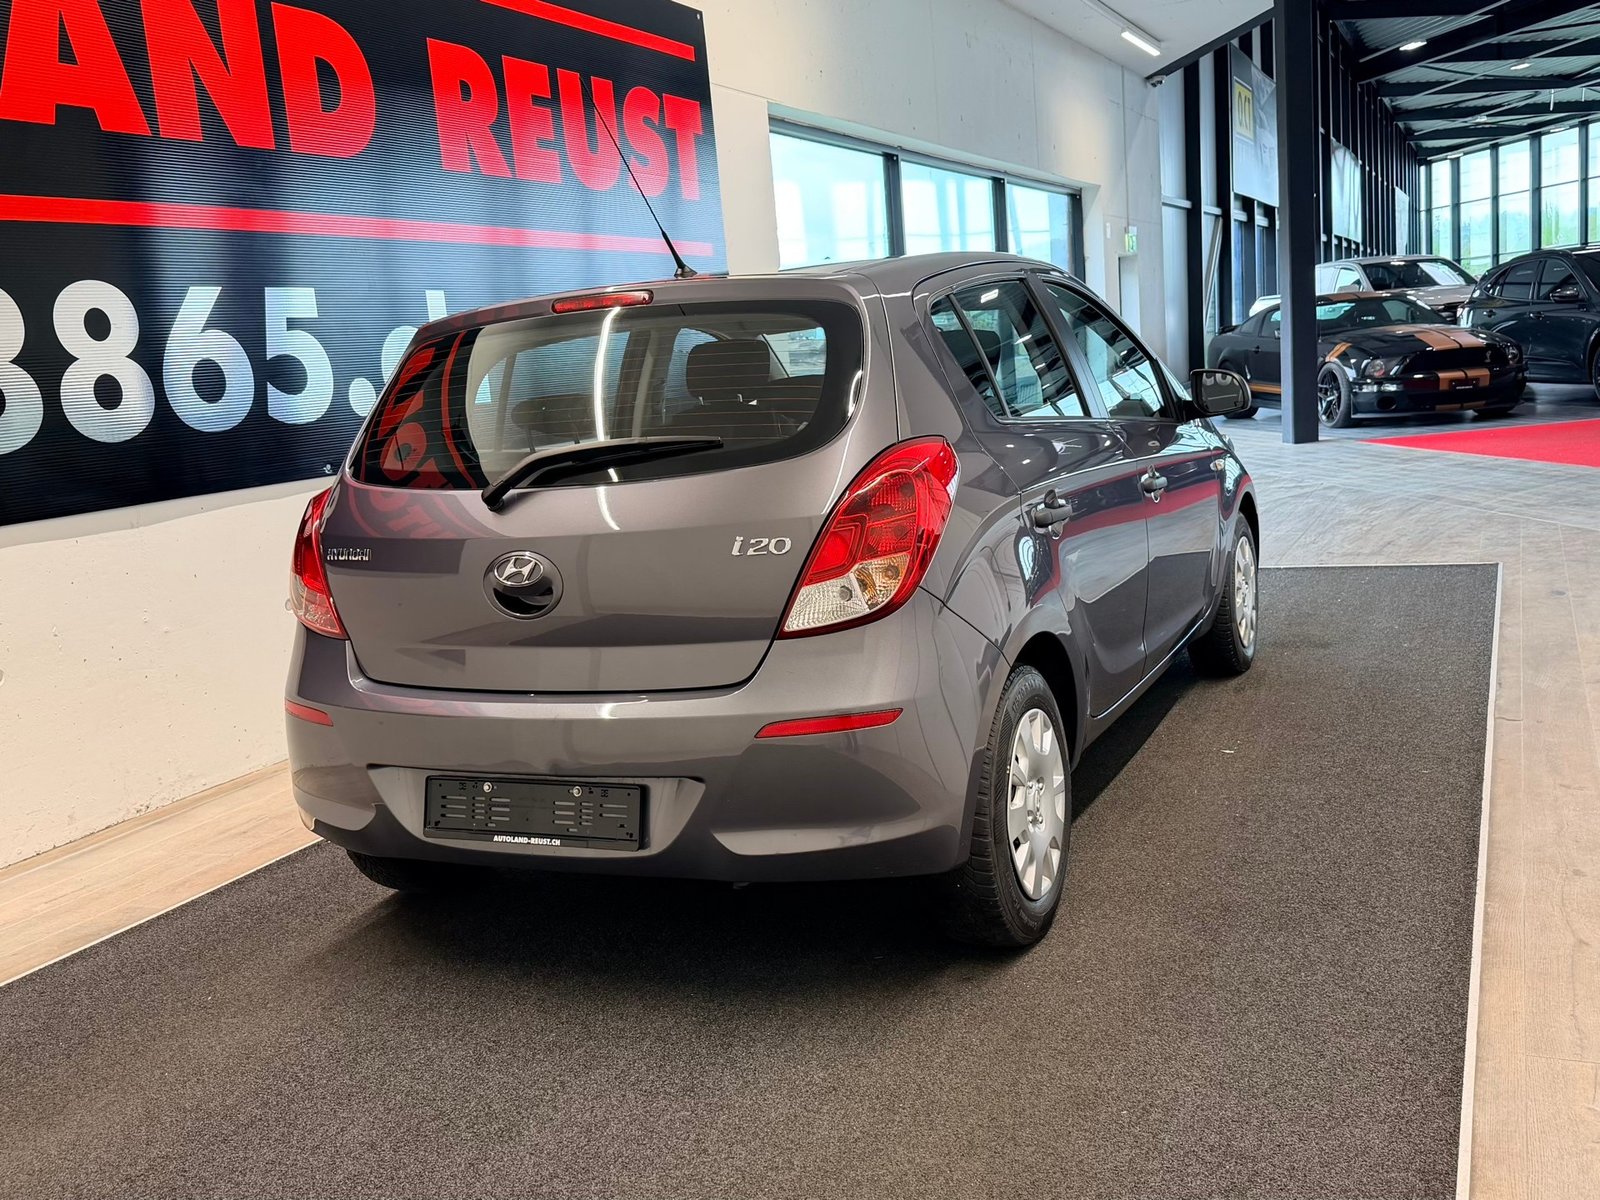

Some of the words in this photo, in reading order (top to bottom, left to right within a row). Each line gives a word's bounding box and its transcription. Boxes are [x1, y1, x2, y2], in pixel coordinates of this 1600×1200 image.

[427, 37, 704, 202] REUST
[731, 535, 792, 556] i20
[326, 548, 372, 561] HYUNDAI
[493, 835, 561, 846] AUTOLAND-REUST.CH
